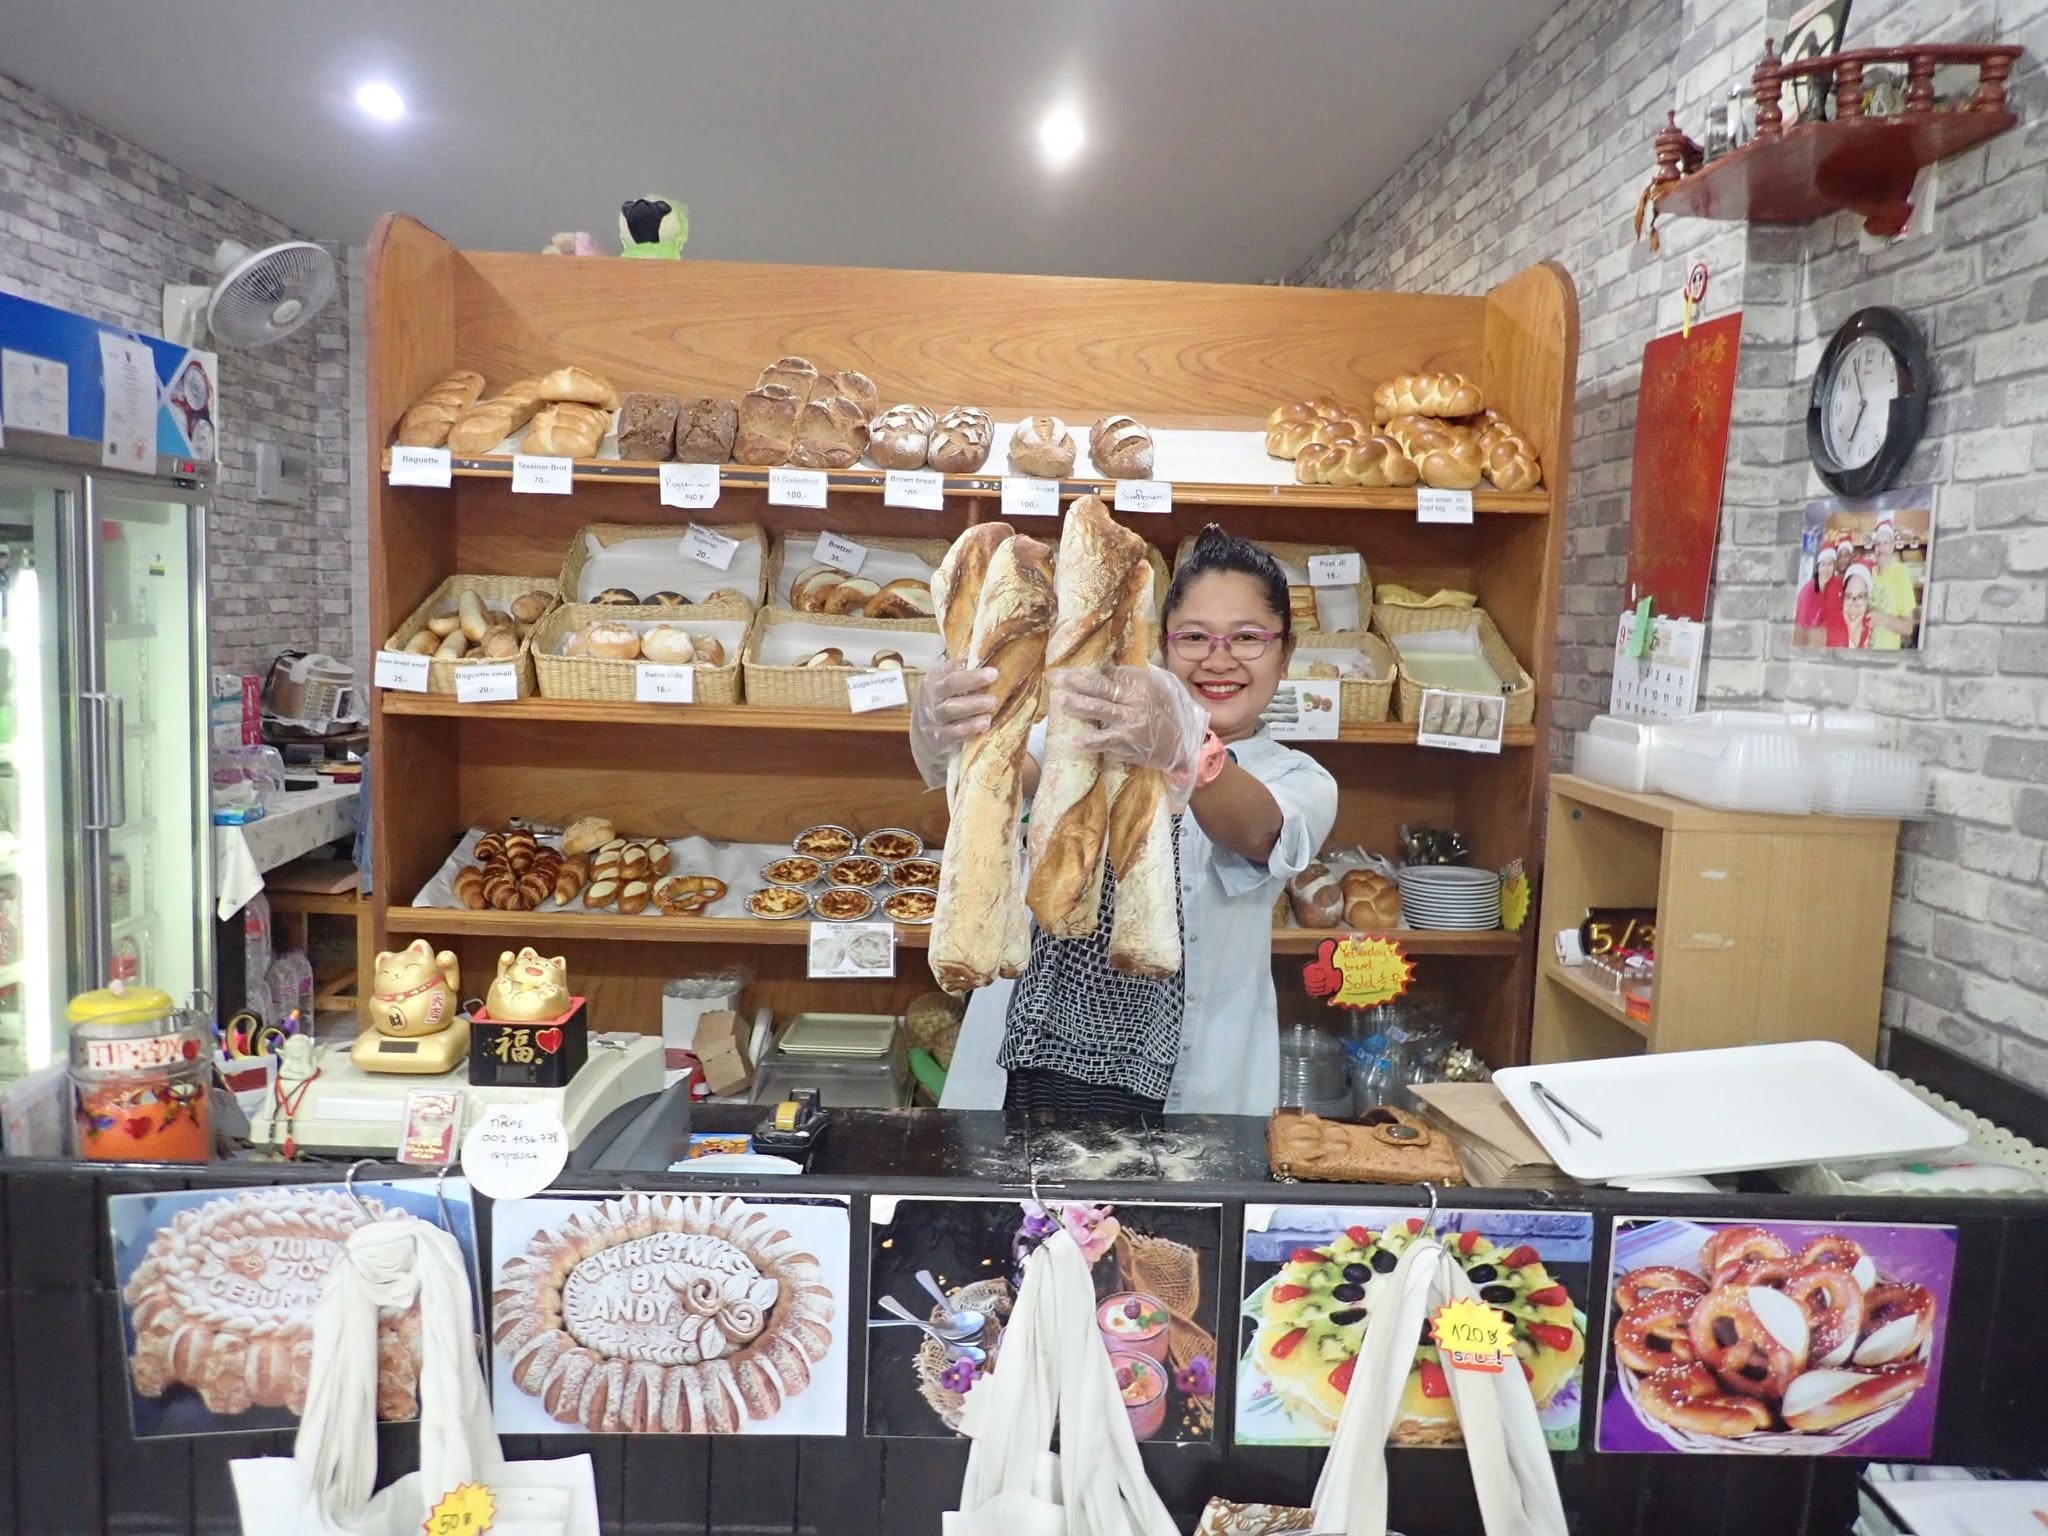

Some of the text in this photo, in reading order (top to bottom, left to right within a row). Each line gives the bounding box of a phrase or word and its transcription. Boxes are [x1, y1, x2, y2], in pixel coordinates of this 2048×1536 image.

[401, 455, 440, 465] Baguette
[517, 461, 568, 472] Tessiner Brot
[890, 475, 937, 486] Brown bread
[828, 540, 853, 555] Bretzel
[1619, 625, 1627, 645] 9
[1652, 689, 1659, 701] 10
[1663, 692, 1670, 704] 11
[1675, 695, 1683, 707] 12
[1344, 973, 1377, 991] Sold
[494, 1026, 536, 1064] 福
[580, 1240, 752, 1283] CHRISTMAS
[631, 1269, 666, 1292] BY
[589, 1295, 672, 1325] ANDY
[1451, 1323, 1484, 1343] 120
[1453, 1349, 1503, 1365] SALE!
[438, 1513, 460, 1535] 50
